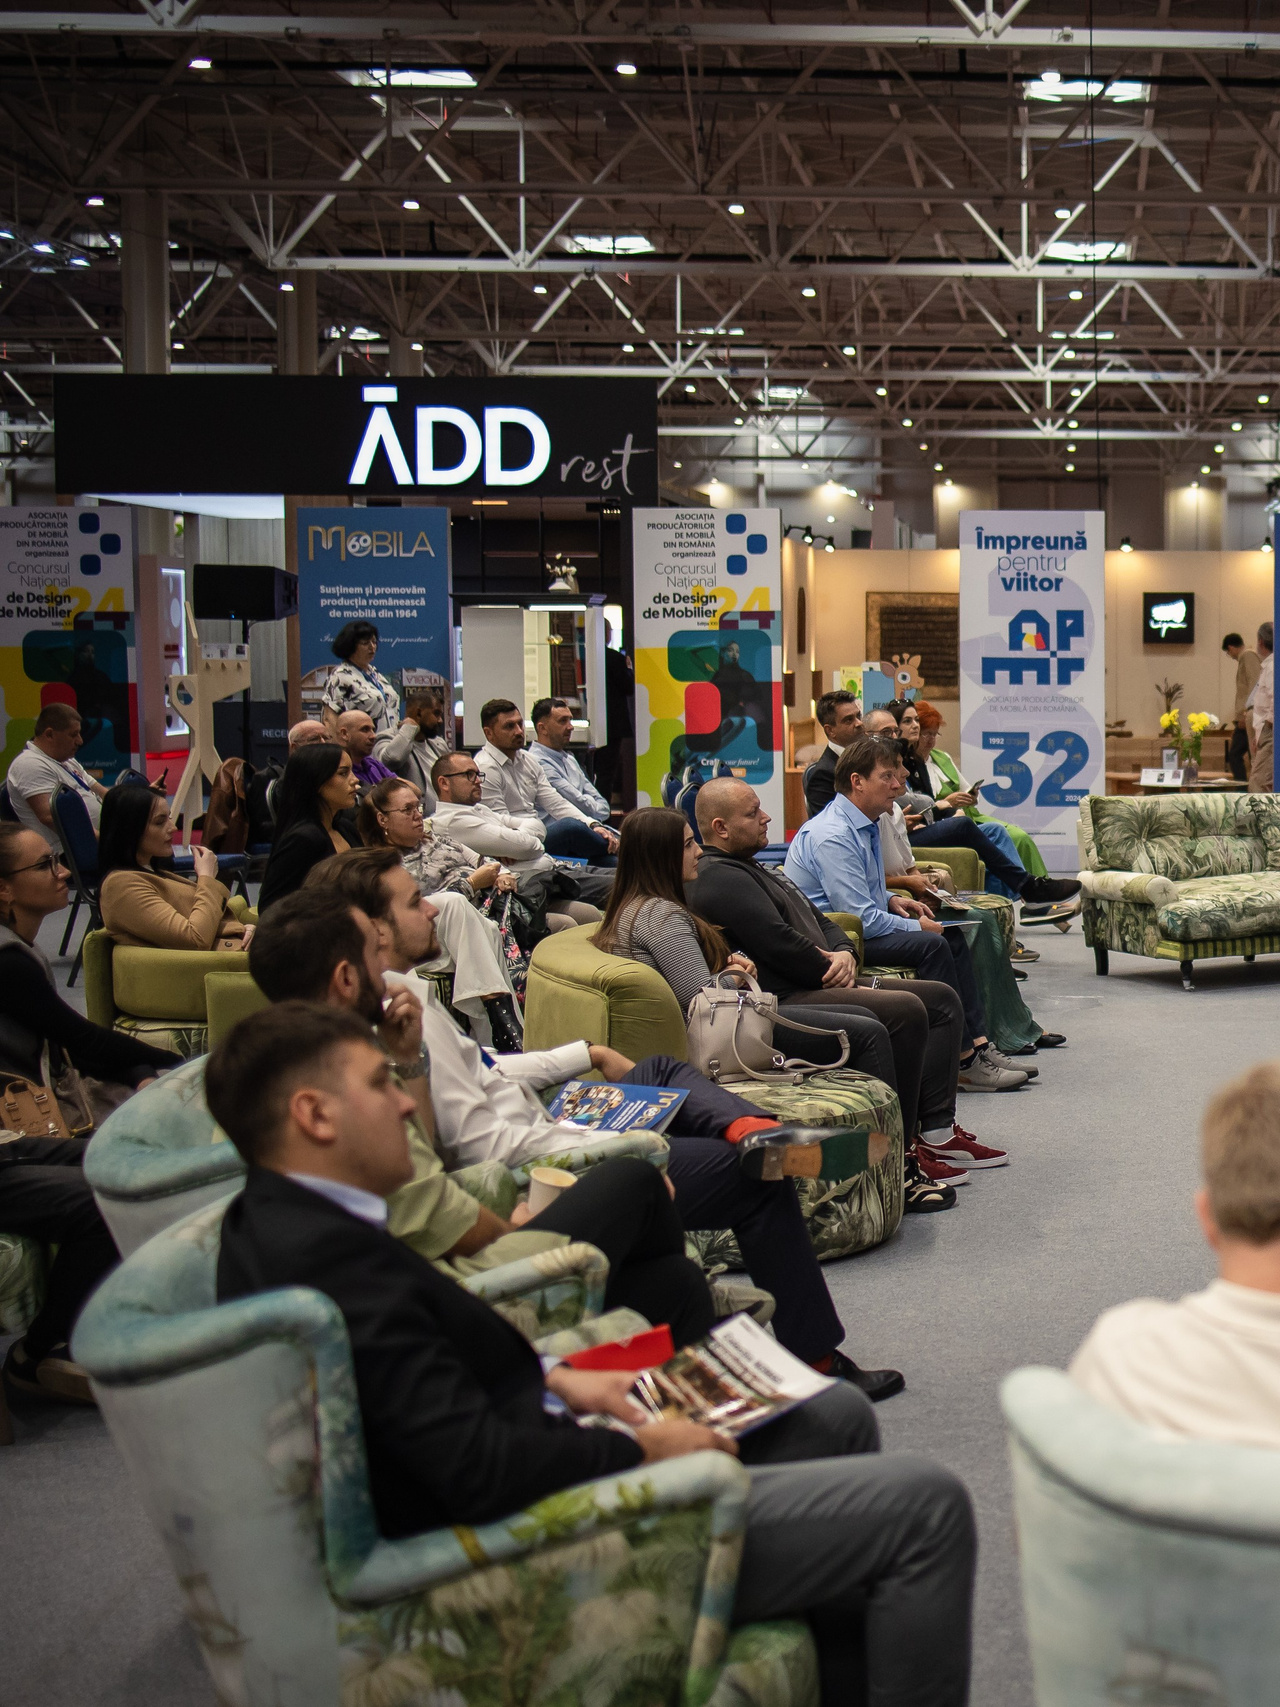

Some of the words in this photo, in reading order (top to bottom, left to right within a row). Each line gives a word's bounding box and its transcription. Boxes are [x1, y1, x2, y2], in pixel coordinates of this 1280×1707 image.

[560, 433, 655, 496] rest
[675, 513, 715, 522] ASOCIAȚIA
[647, 521, 715, 530] PRODUCĂTORILOR
[685, 531, 716, 539] MOBILĂ
[975, 526, 1087, 554] Împreună
[16, 540, 30, 548] DIN
[31, 539, 69, 547] ROMÂNIA
[663, 541, 677, 549] DIN
[678, 540, 716, 549] ROMÂNIA
[7, 561, 70, 574] Concursul
[654, 562, 717, 575] Concursul
[997, 554, 1067, 576] pentru
[666, 576, 717, 590] Național
[1000, 571, 1064, 592] viitor
[319, 585, 364, 596] Susținem
[374, 585, 426, 596] promovăm
[6, 592, 23, 604] de
[26, 592, 72, 606] Design
[320, 597, 367, 608] producția
[368, 597, 426, 606] românească
[652, 592, 670, 604] de
[672, 592, 717, 607] Design
[0, 606, 15, 619] de
[16, 606, 73, 619] Mobilier
[329, 609, 342, 618] de
[343, 609, 377, 618] mobilă
[378, 609, 394, 618] din
[395, 609, 418, 618] 1964
[642, 607, 660, 619] de
[662, 607, 717, 619] Mobilier
[1043, 704, 1077, 712] ROMÂNIA
[989, 737, 1005, 745] 1992
[979, 730, 1090, 808] 32
